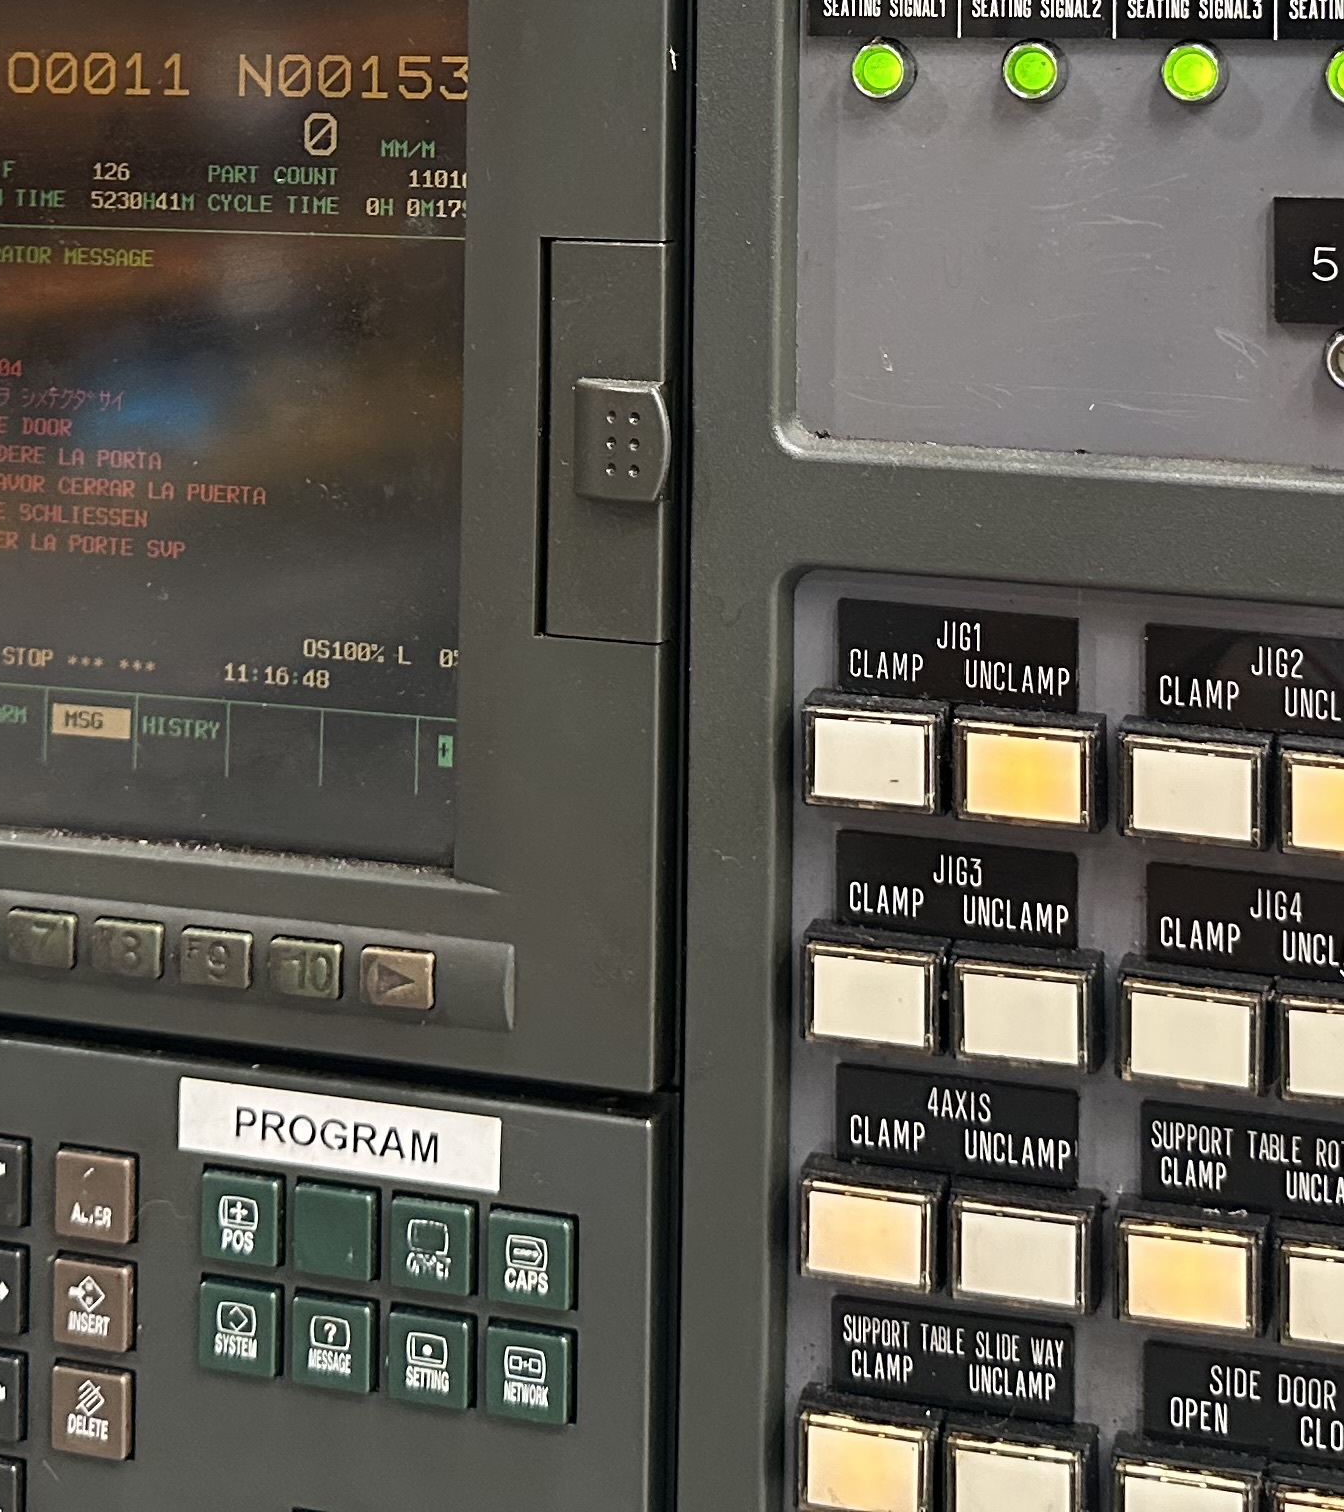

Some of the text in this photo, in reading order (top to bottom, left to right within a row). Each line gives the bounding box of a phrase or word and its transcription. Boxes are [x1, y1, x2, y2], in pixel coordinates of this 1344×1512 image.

[238, 54, 468, 100] N00153
[381, 140, 435, 158] MM/M
[208, 165, 338, 185] PART COUNT
[208, 194, 339, 214] CYCLE TIME
[64, 247, 154, 267] MESSAGE
[1312, 247, 1338, 281] 5
[23, 417, 72, 436] DOOR
[937, 621, 982, 652] JIG1
[224, 663, 330, 688] 11:16:48
[849, 648, 1070, 697] CLAMP UNCLAMP
[1251, 646, 1304, 678] JIG2
[1159, 675, 1240, 712] CLAMP
[143, 716, 220, 741] HISTRY
[934, 855, 983, 887] JIG3
[849, 881, 1070, 935] CLAMP UNCLAMP
[1250, 888, 1302, 922] JIG4
[1160, 917, 1241, 954] CLAMP
[927, 1088, 991, 1122] 4AXIS
[235, 1106, 438, 1163] PROGRAM
[850, 1115, 1071, 1171] CLAMP UNCLAMP
[1152, 1120, 1233, 1158] SUPPORT
[1248, 1131, 1301, 1164] TABLE
[1160, 1157, 1227, 1192] CLAMP
[221, 1230, 253, 1253] POS
[504, 1268, 548, 1295] CAPS
[68, 1311, 110, 1337] INSERT
[214, 1333, 257, 1360] SYSTEM
[843, 1315, 1064, 1368] SUPPORT TABLE SLIDE WAY
[308, 1349, 351, 1375] MESSAGE
[851, 1350, 1057, 1402] CLAMP UNCLAMP
[406, 1366, 449, 1392] SETTING
[503, 1381, 549, 1407] NETWORK
[1210, 1365, 1337, 1411] SIDE DOOR
[67, 1413, 109, 1441] DELETE
[1170, 1397, 1229, 1434] OPEN
